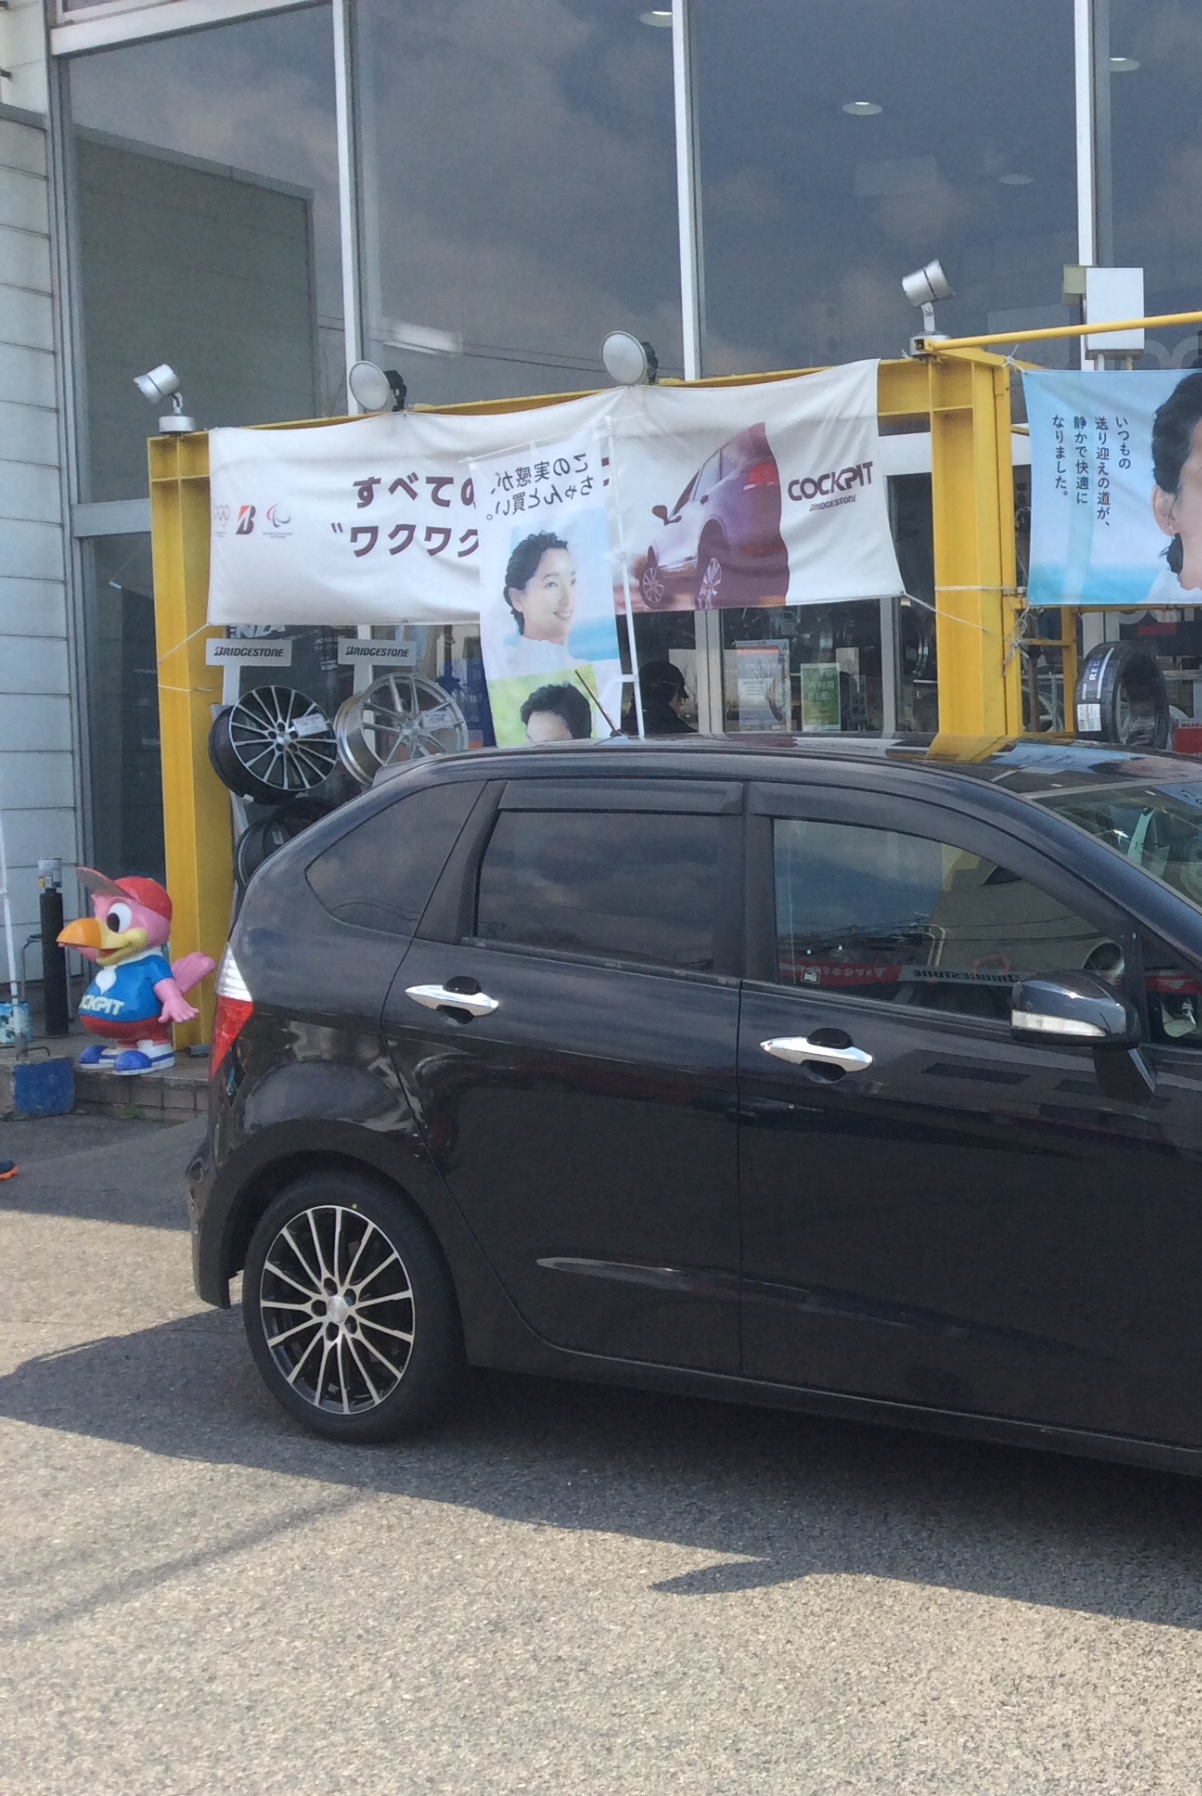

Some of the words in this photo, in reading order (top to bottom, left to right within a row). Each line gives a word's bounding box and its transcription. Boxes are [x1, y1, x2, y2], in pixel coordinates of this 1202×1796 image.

[1052, 415, 1068, 496] なりました。
[1073, 415, 1089, 504] 静かで快適に
[1115, 416, 1131, 470] いつもの
[788, 461, 873, 501] COCKPIT
[809, 495, 857, 512] BRIDGESTONE
[214, 646, 284, 658] BRIDGESTONE
[345, 646, 410, 658] BRIDGESTONE
